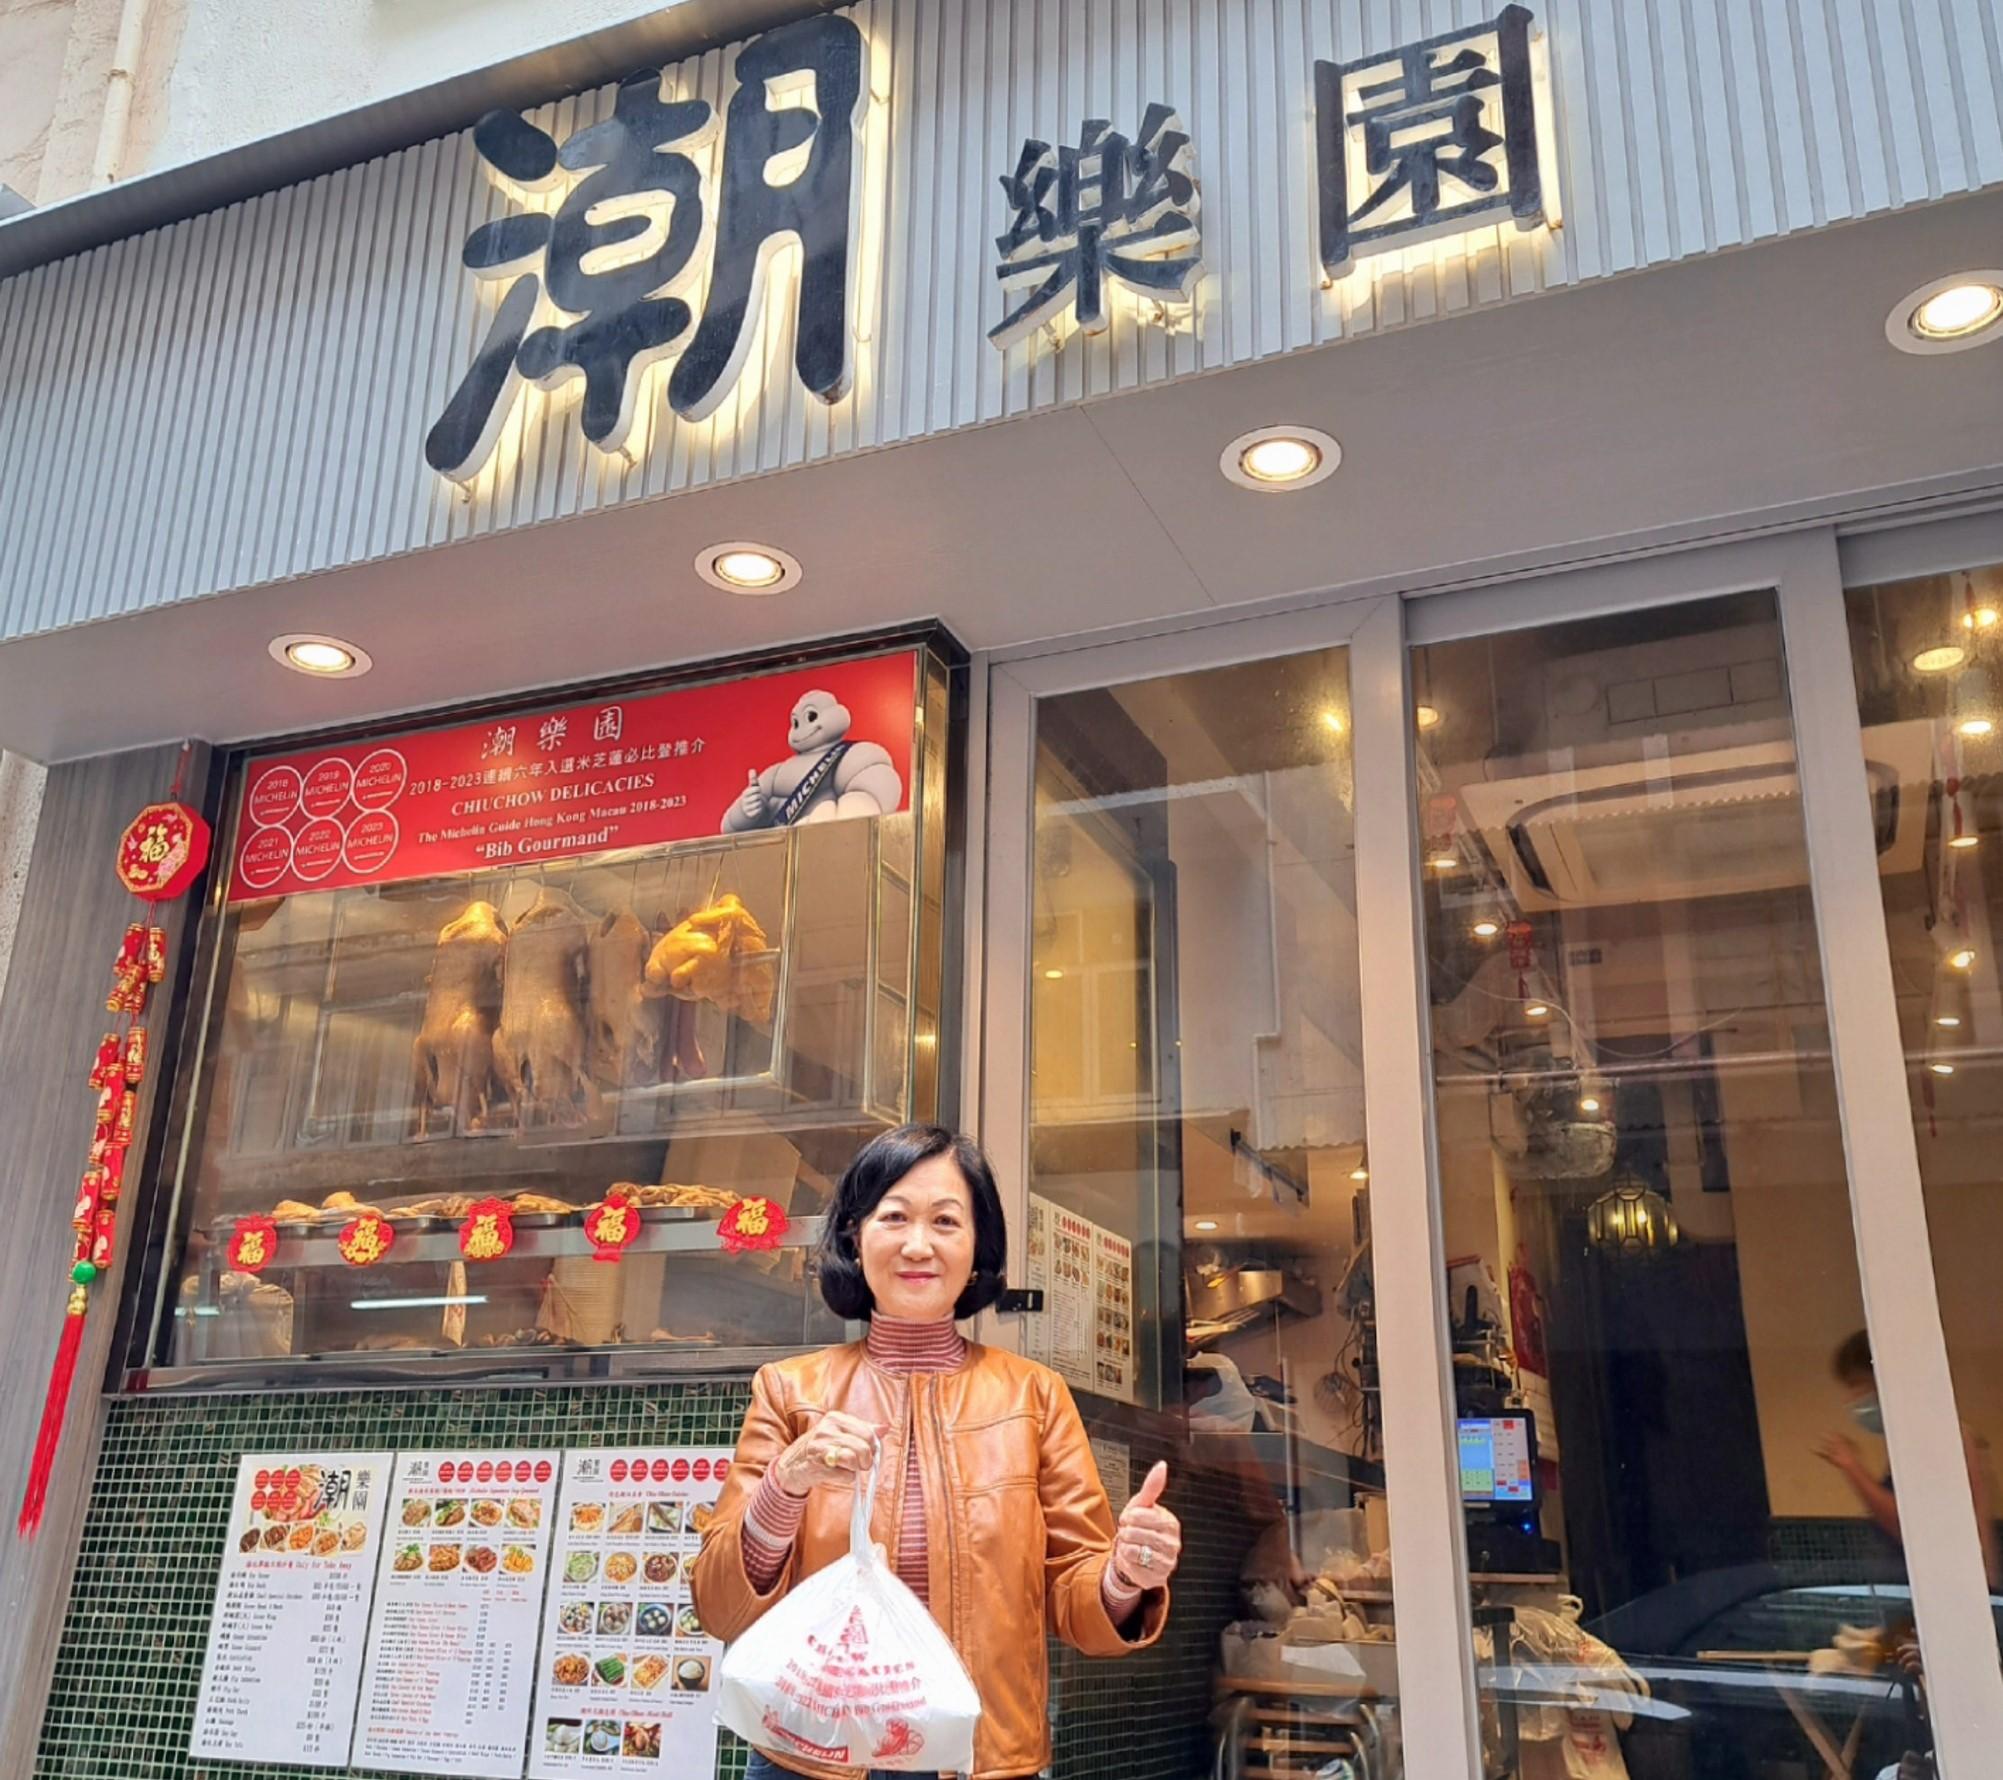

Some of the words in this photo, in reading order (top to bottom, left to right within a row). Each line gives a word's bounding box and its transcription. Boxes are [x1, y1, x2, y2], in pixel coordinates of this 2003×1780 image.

[425, 5, 1546, 482] 潮樂園
[254, 790, 298, 804] MICHELIN
[305, 782, 349, 796] MICHELIN
[356, 774, 401, 788] MICHELIN
[451, 790, 545, 817] CHIUCHOW
[550, 773, 655, 801] DELICACIES
[418, 831, 438, 843] The
[440, 821, 486, 840] Michelin
[489, 819, 521, 834] Guide
[524, 815, 553, 830] Hong
[556, 810, 586, 826] Kong
[590, 804, 627, 819] Macau
[630, 795, 687, 814] 2018-2023
[139, 823, 170, 863] 福
[245, 848, 289, 863] MICHELIN
[295, 841, 340, 856] MICHELIN
[347, 833, 393, 848] MICHELIN
[354, 1217, 378, 1248] 福
[471, 1214, 500, 1248] 福
[594, 1206, 627, 1243] 福
[735, 1198, 769, 1235] 福
[237, 1231, 263, 1264] 福
